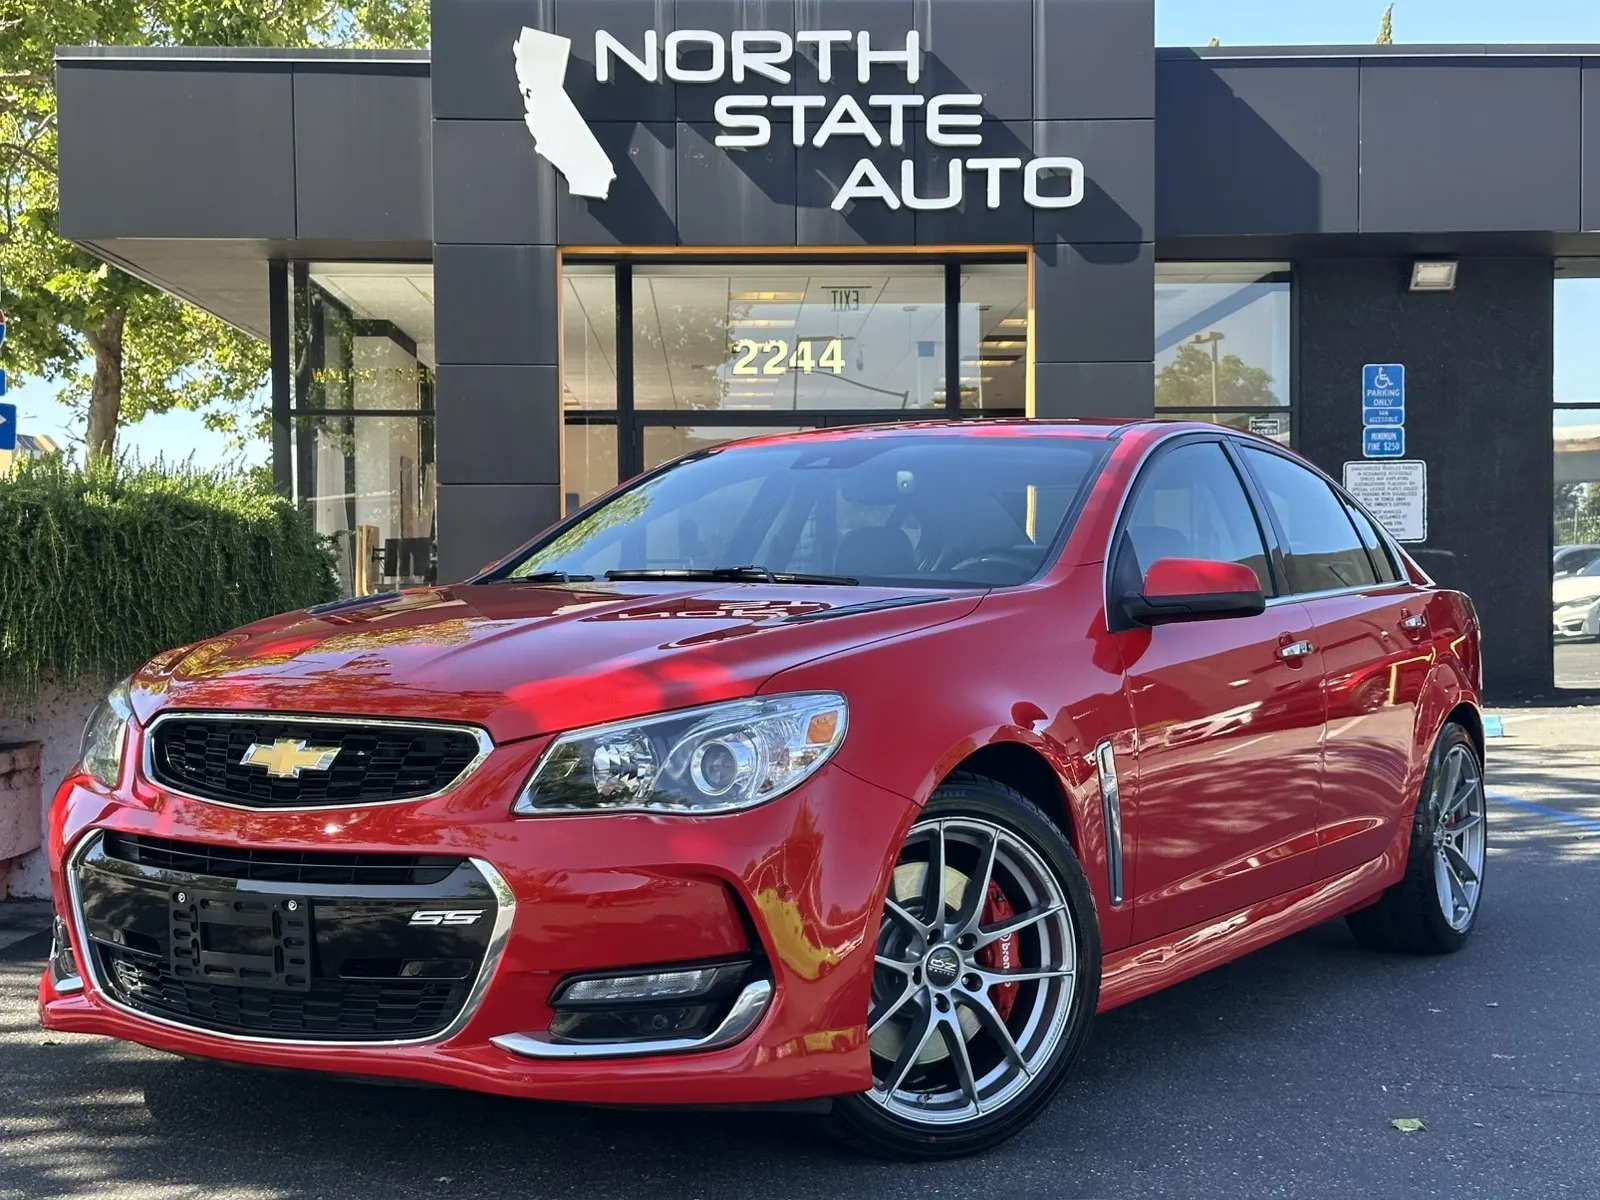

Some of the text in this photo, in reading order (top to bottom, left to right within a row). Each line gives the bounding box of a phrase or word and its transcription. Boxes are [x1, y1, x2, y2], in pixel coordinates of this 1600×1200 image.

[595, 29, 920, 84] NORTH
[713, 94, 983, 147] STATE
[831, 157, 1085, 210] AUTO
[732, 338, 846, 375] 2244
[1366, 389, 1401, 397] PARKING
[1367, 443, 1400, 452] FINE $250
[1371, 433, 1397, 441] MINIMUM
[408, 909, 488, 926] SS
